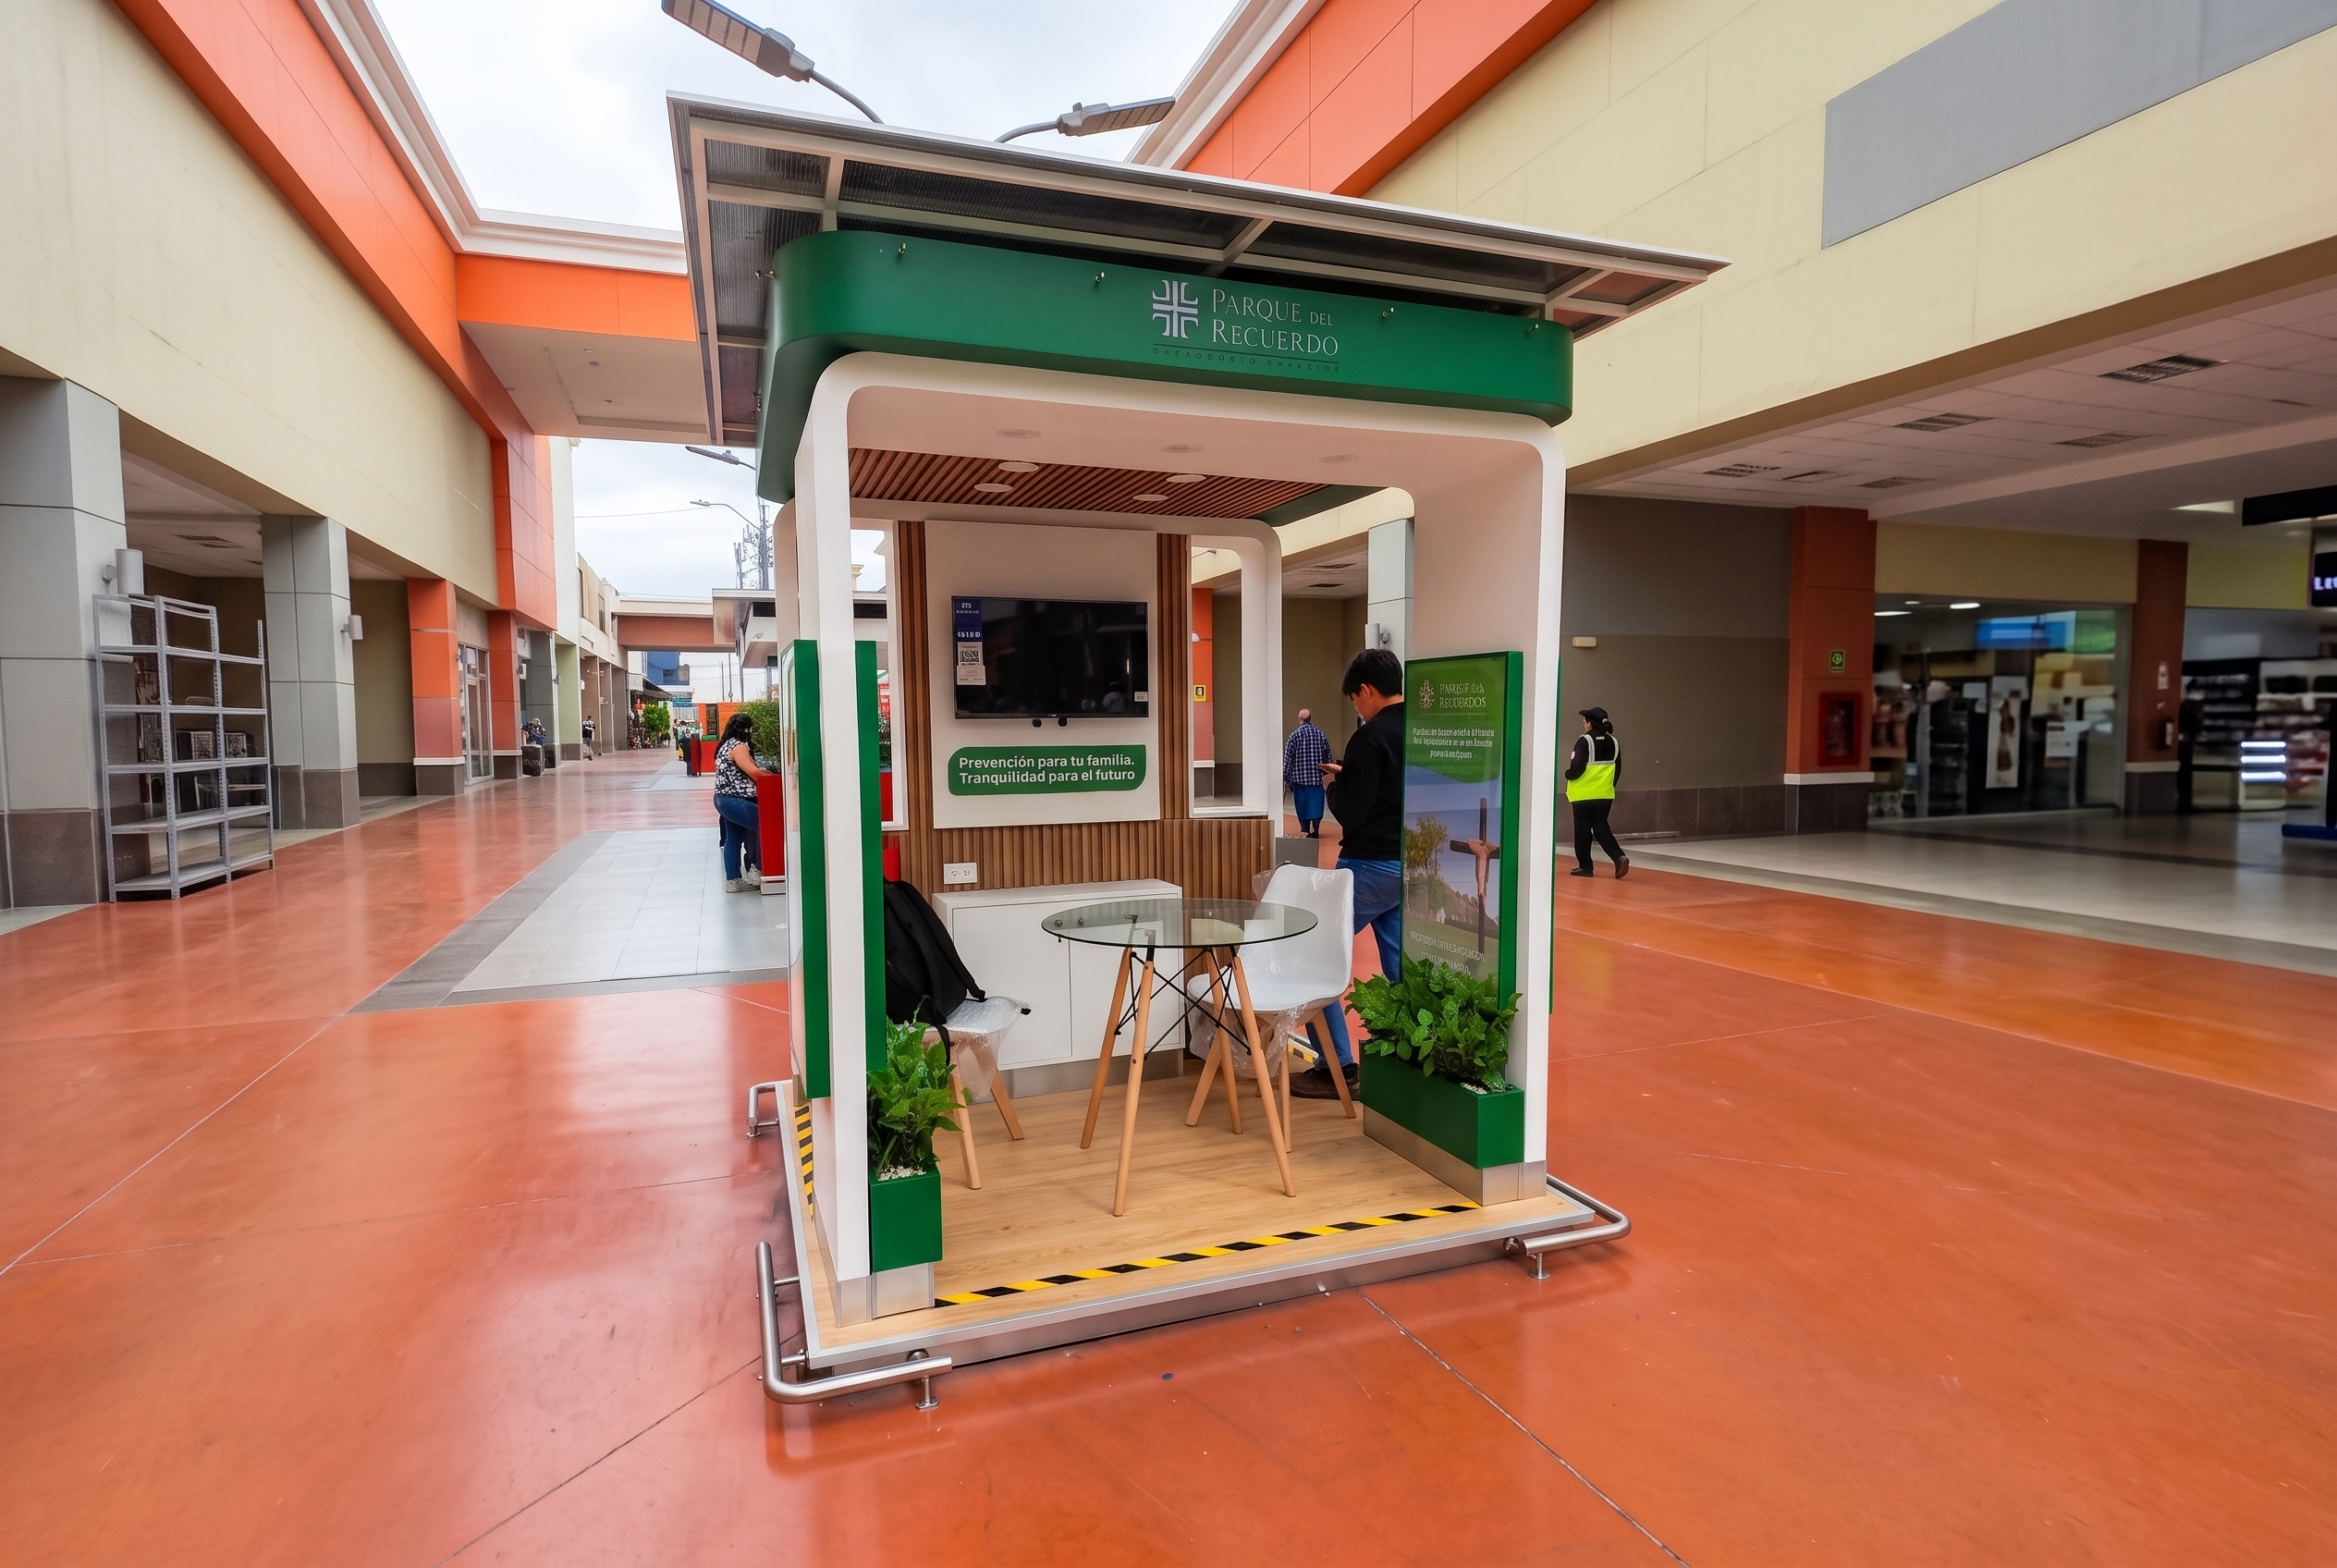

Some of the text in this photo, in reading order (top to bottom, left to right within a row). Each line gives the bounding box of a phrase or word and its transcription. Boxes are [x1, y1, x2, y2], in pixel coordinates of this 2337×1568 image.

[1212, 288, 1333, 326] PARQUE DEL
[1212, 319, 1339, 356] RECUERDO
[959, 753, 1135, 770] Prevención para tu familia.
[959, 769, 1136, 786] Tranquilidad para el futuro
